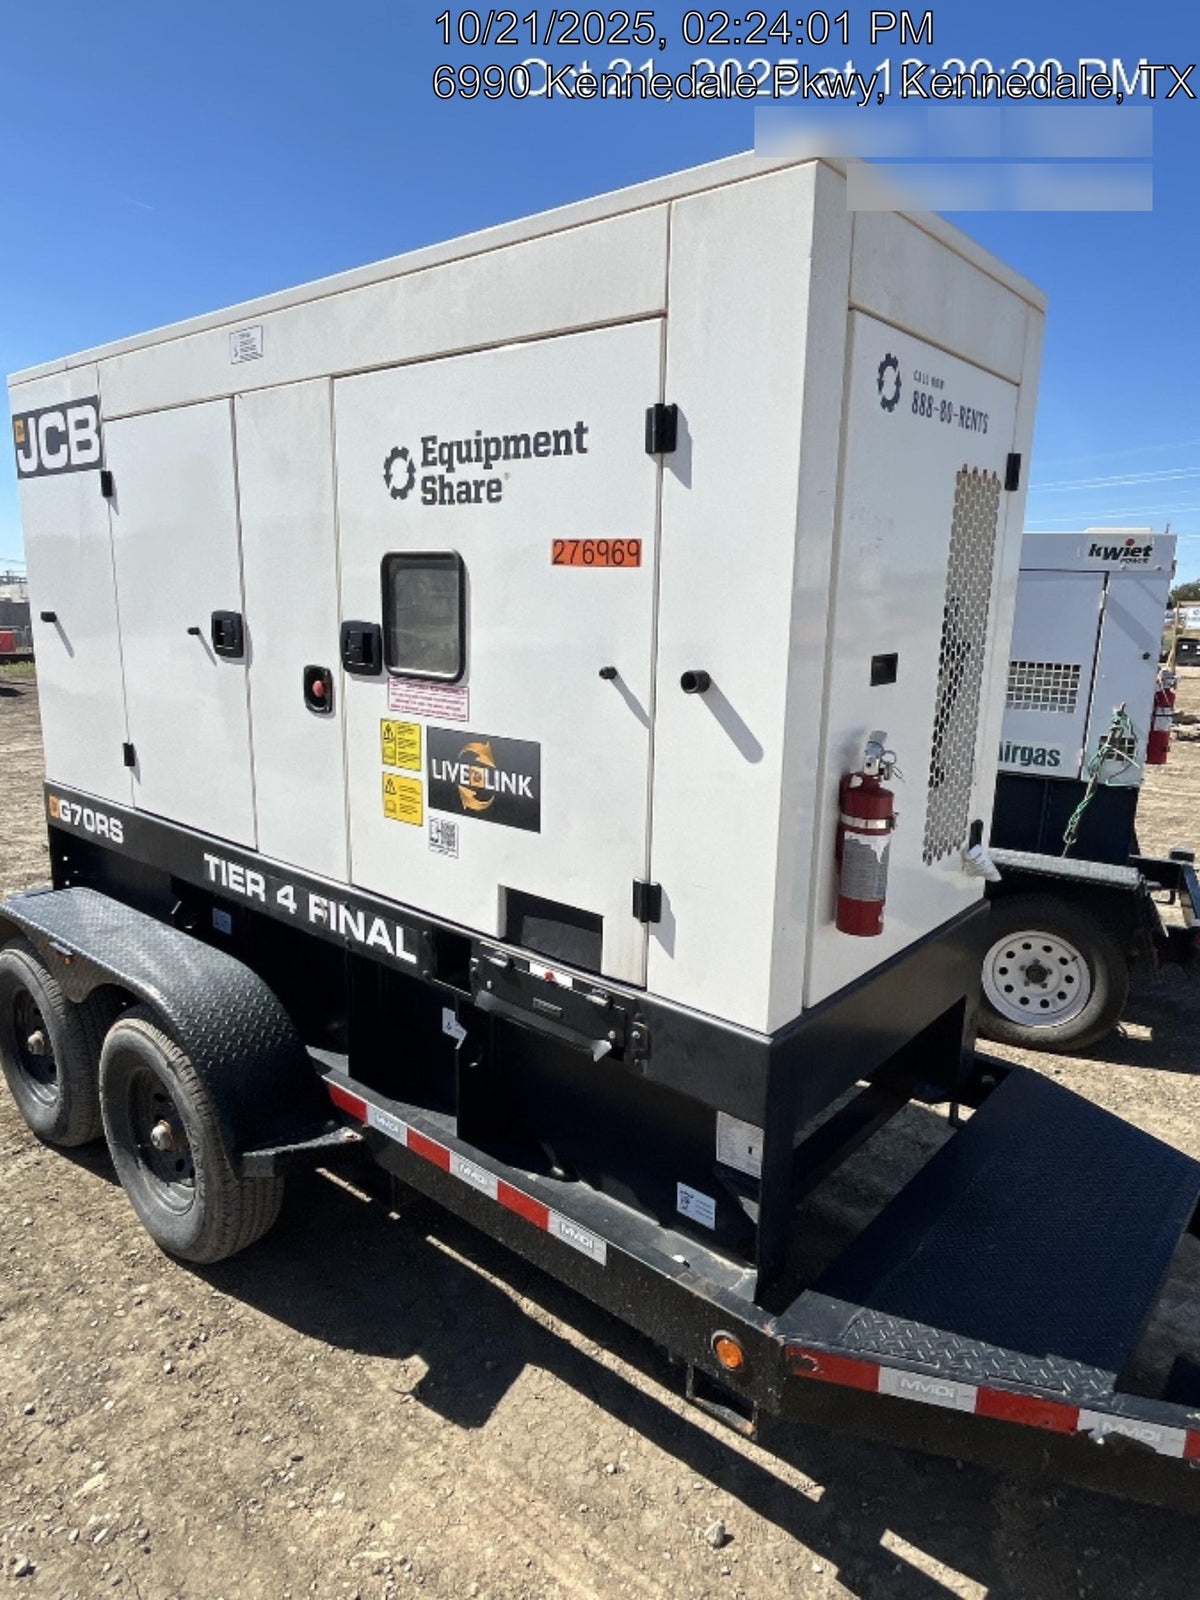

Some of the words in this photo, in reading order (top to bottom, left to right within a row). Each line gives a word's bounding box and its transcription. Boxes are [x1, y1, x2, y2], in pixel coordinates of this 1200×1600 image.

[16, 404, 100, 473] JCB
[420, 420, 589, 472] Equipment
[420, 474, 502, 505] Share
[552, 539, 640, 566] 276969
[1088, 537, 1153, 560] kwiet
[432, 758, 470, 786] LIVE
[484, 767, 534, 800] LINK
[59, 799, 124, 844] G70RS
[203, 852, 266, 903] TIER
[276, 884, 298, 915] 4
[308, 892, 418, 965] FINAL
